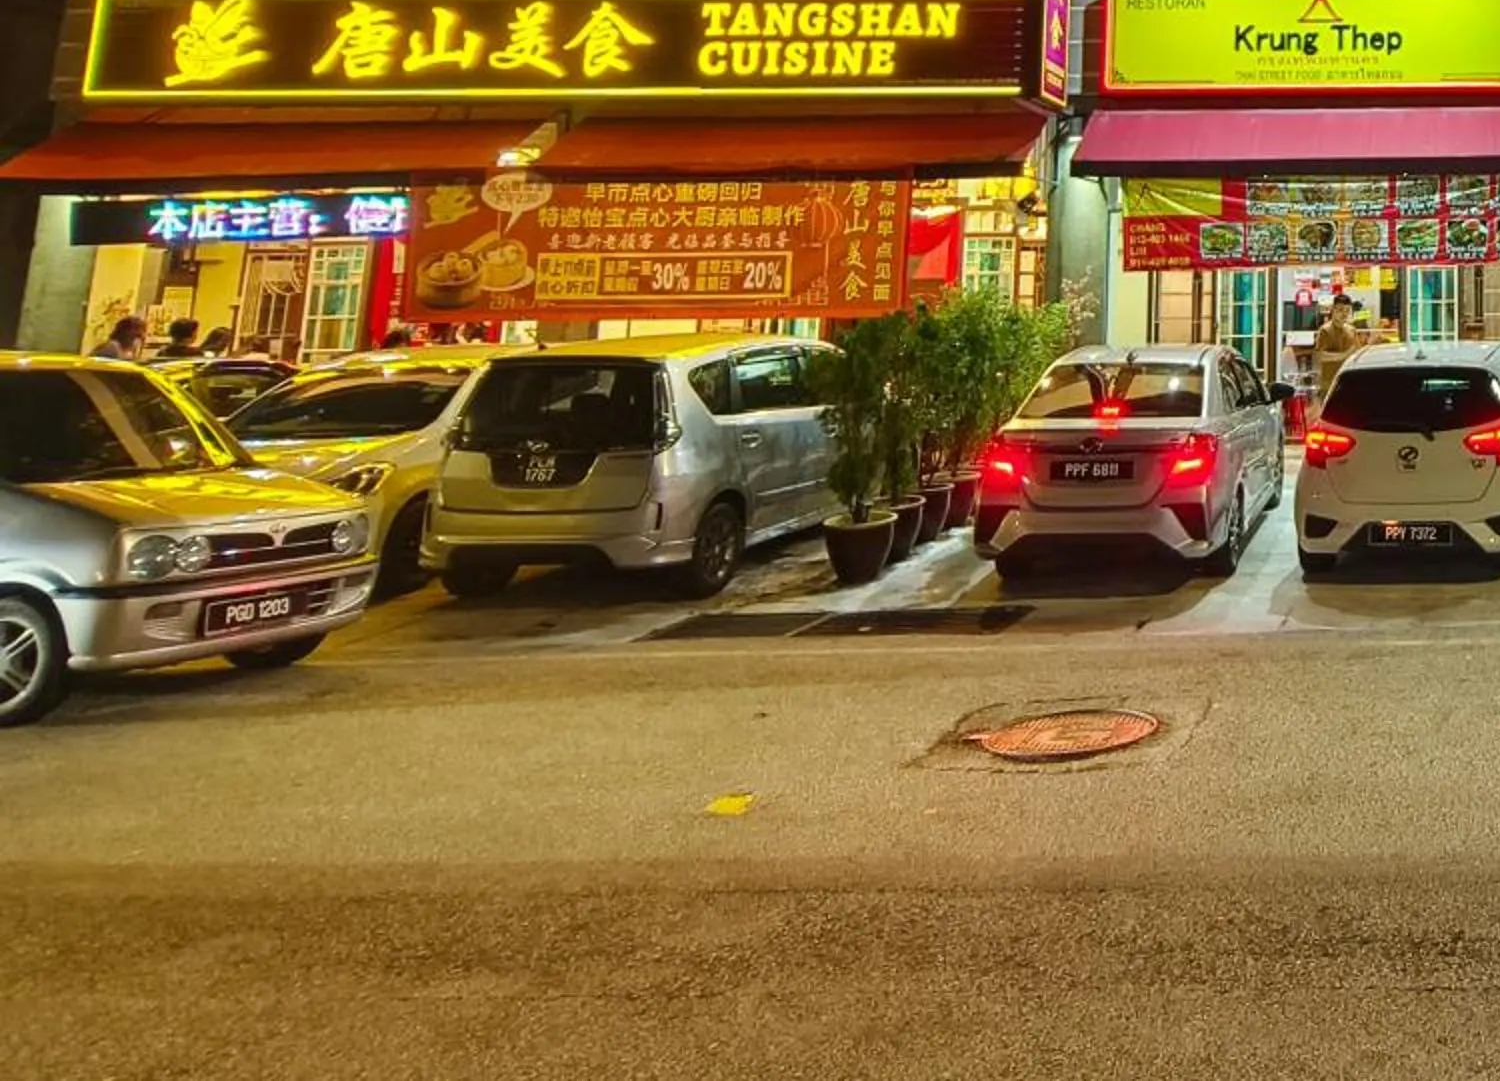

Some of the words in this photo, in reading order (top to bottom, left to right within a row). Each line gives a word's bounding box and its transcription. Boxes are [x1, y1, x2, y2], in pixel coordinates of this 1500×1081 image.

[701, 2, 961, 38] TANGSHAN
[312, 0, 655, 79] 唐山美食
[1234, 24, 1319, 55] Krung
[1331, 24, 1403, 54] Thep
[698, 41, 897, 77] CUISINE
[839, 180, 871, 301] 唐山美食
[652, 262, 690, 291] 30%
[743, 260, 783, 290] 20%
[1064, 462, 1091, 478] PPF
[1385, 525, 1407, 541] PPY
[1409, 525, 1438, 541] 7372
[258, 596, 290, 619] 1203
